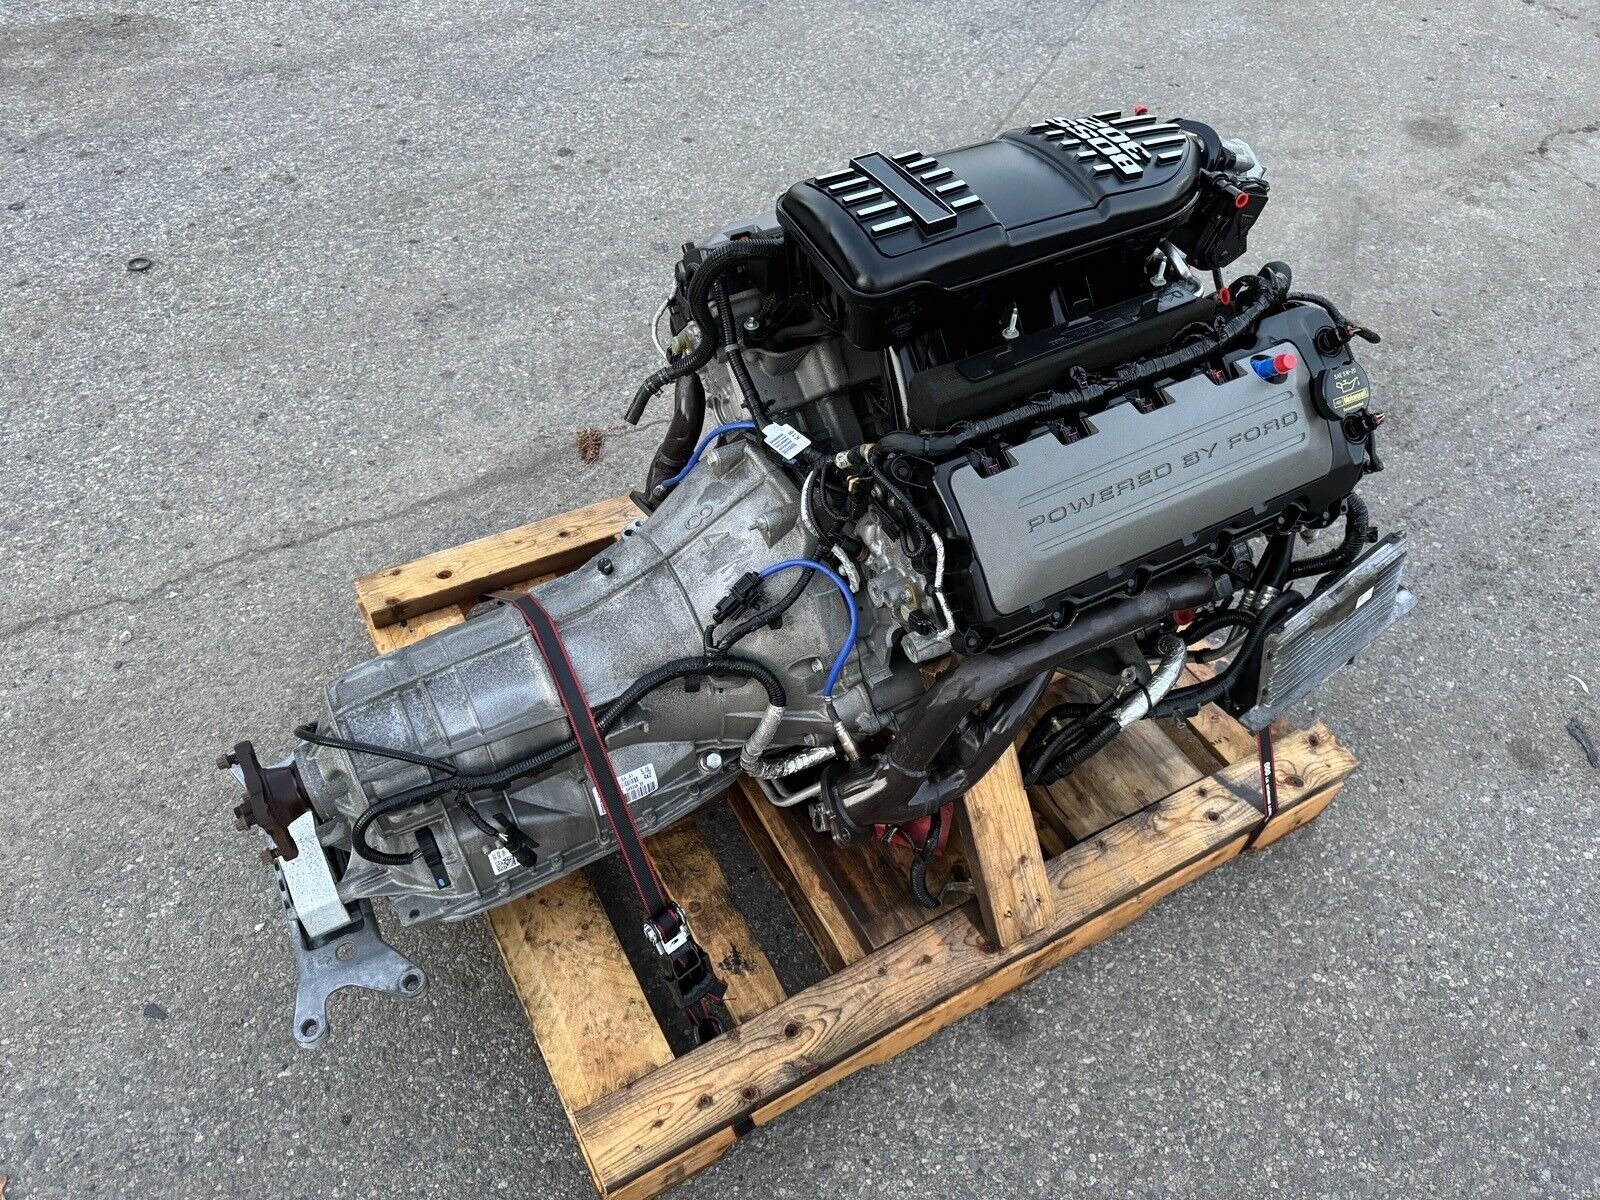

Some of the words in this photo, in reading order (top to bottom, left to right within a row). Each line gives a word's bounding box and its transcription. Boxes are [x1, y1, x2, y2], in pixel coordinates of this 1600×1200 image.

[1045, 117, 1144, 175] BOSS
[1076, 116, 1152, 160] 302
[1027, 462, 1173, 533] POWERED
[1181, 442, 1218, 469] BY
[1228, 410, 1298, 449] FORD
